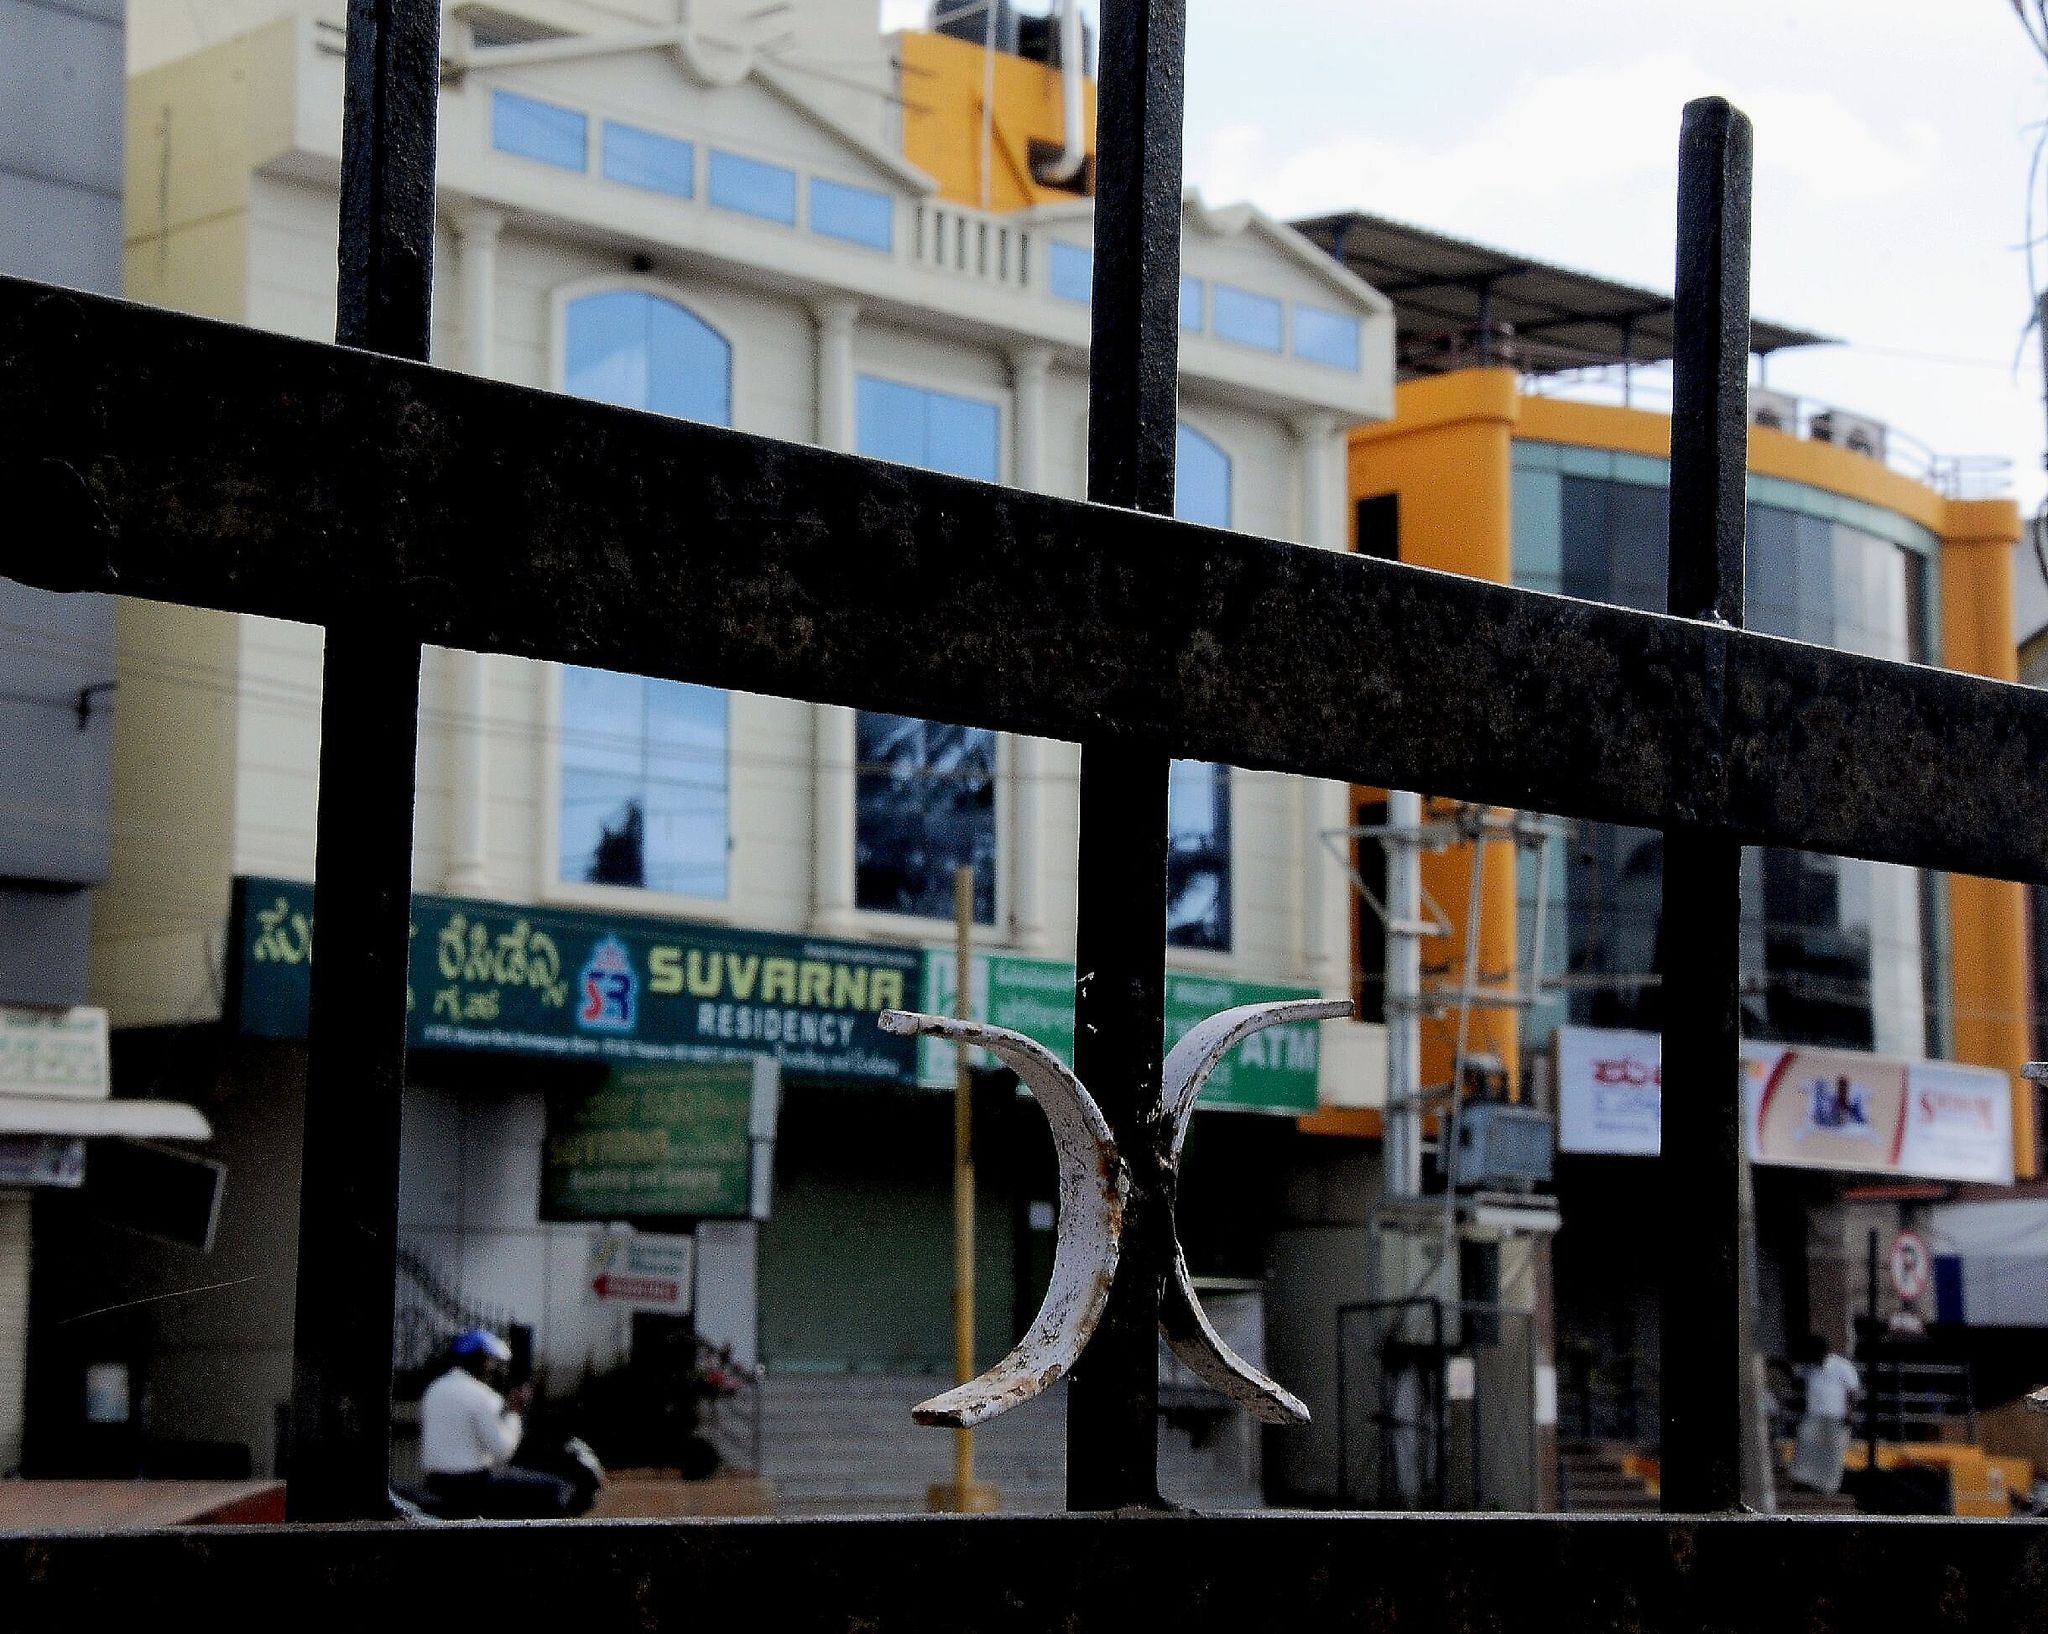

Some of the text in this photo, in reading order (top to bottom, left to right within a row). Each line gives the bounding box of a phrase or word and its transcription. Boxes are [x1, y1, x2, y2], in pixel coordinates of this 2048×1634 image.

[648, 946, 903, 1011] SUVARNA
[698, 1002, 853, 1046] RESIDENCY
[1238, 1026, 1315, 1071] ATM
